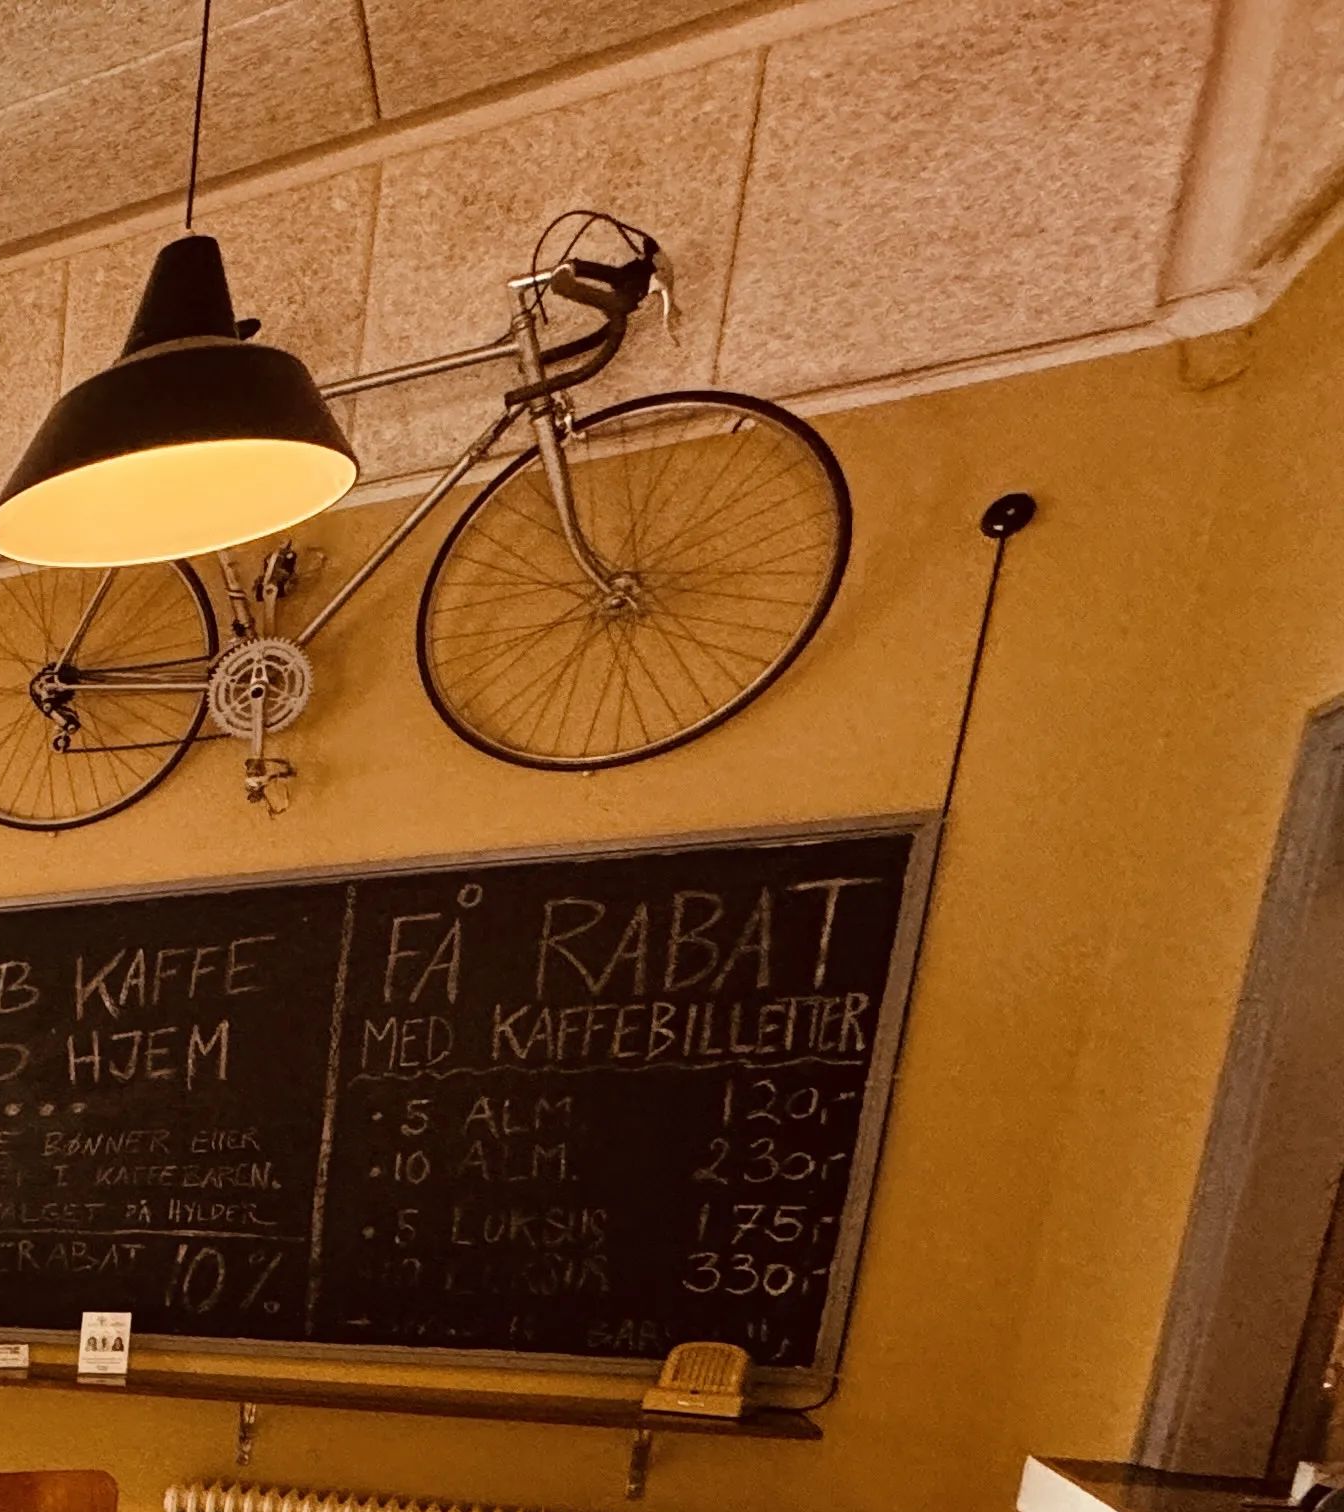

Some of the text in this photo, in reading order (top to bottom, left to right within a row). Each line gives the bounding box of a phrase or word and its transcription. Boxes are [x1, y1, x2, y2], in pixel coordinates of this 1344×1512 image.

[383, 877, 882, 1003] FÅ RABAT
[76, 935, 277, 1021] KAFFE
[361, 992, 870, 1069] MED KAFFEBILLETTER
[67, 1019, 229, 1090] HJEM
[400, 1098, 431, 1137] 5
[41, 1130, 170, 1157] BØNNER
[54, 1165, 69, 1187] I
[394, 1150, 430, 1184] 10
[125, 1199, 150, 1224] PÅ
[394, 1209, 418, 1244] 5
